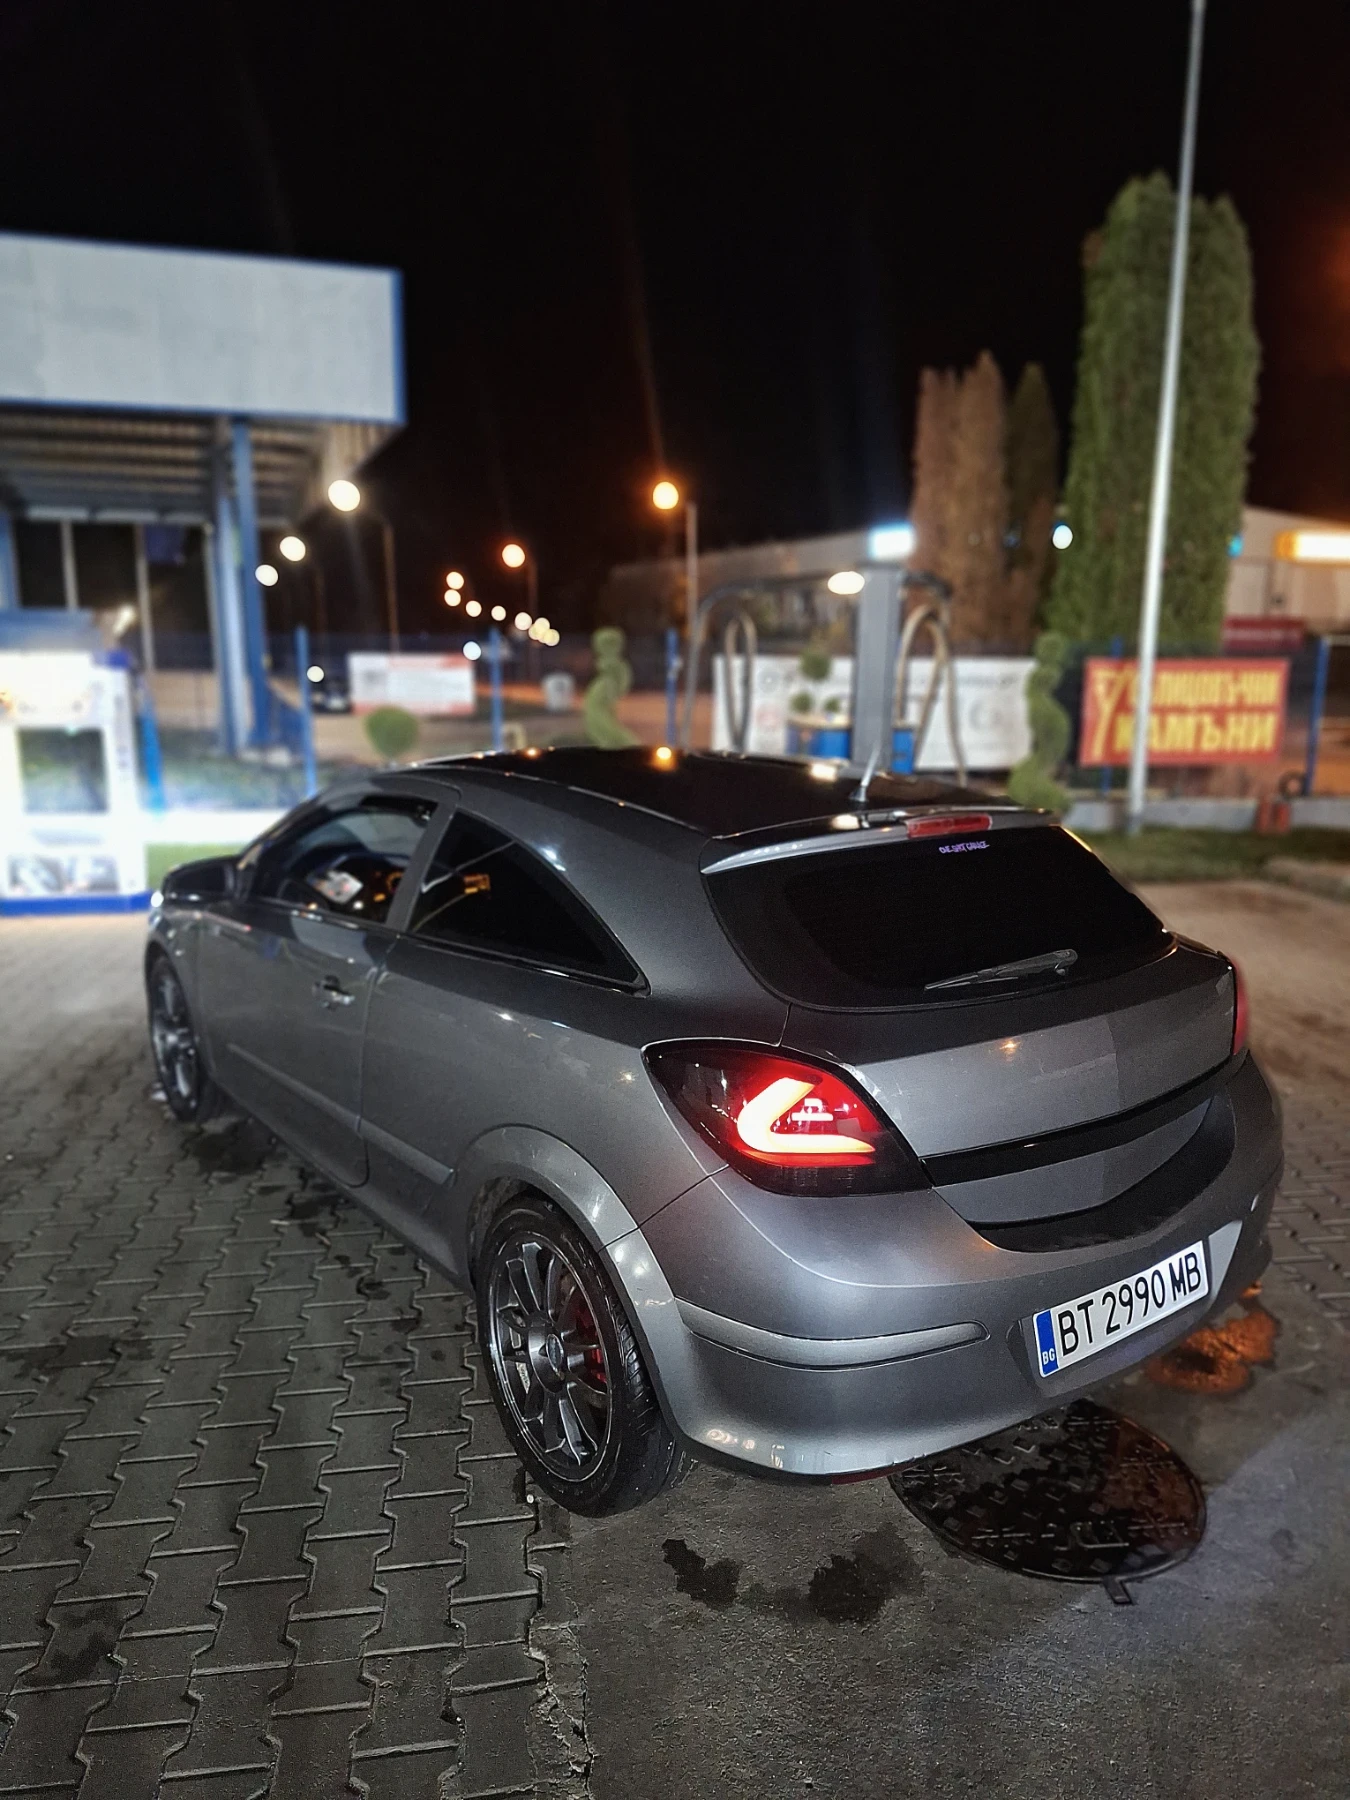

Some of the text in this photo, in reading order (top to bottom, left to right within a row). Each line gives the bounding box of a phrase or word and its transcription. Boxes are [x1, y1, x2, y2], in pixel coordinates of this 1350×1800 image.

[1058, 1252, 1201, 1356] BT 2990 MB
[1042, 1348, 1056, 1365] BG
